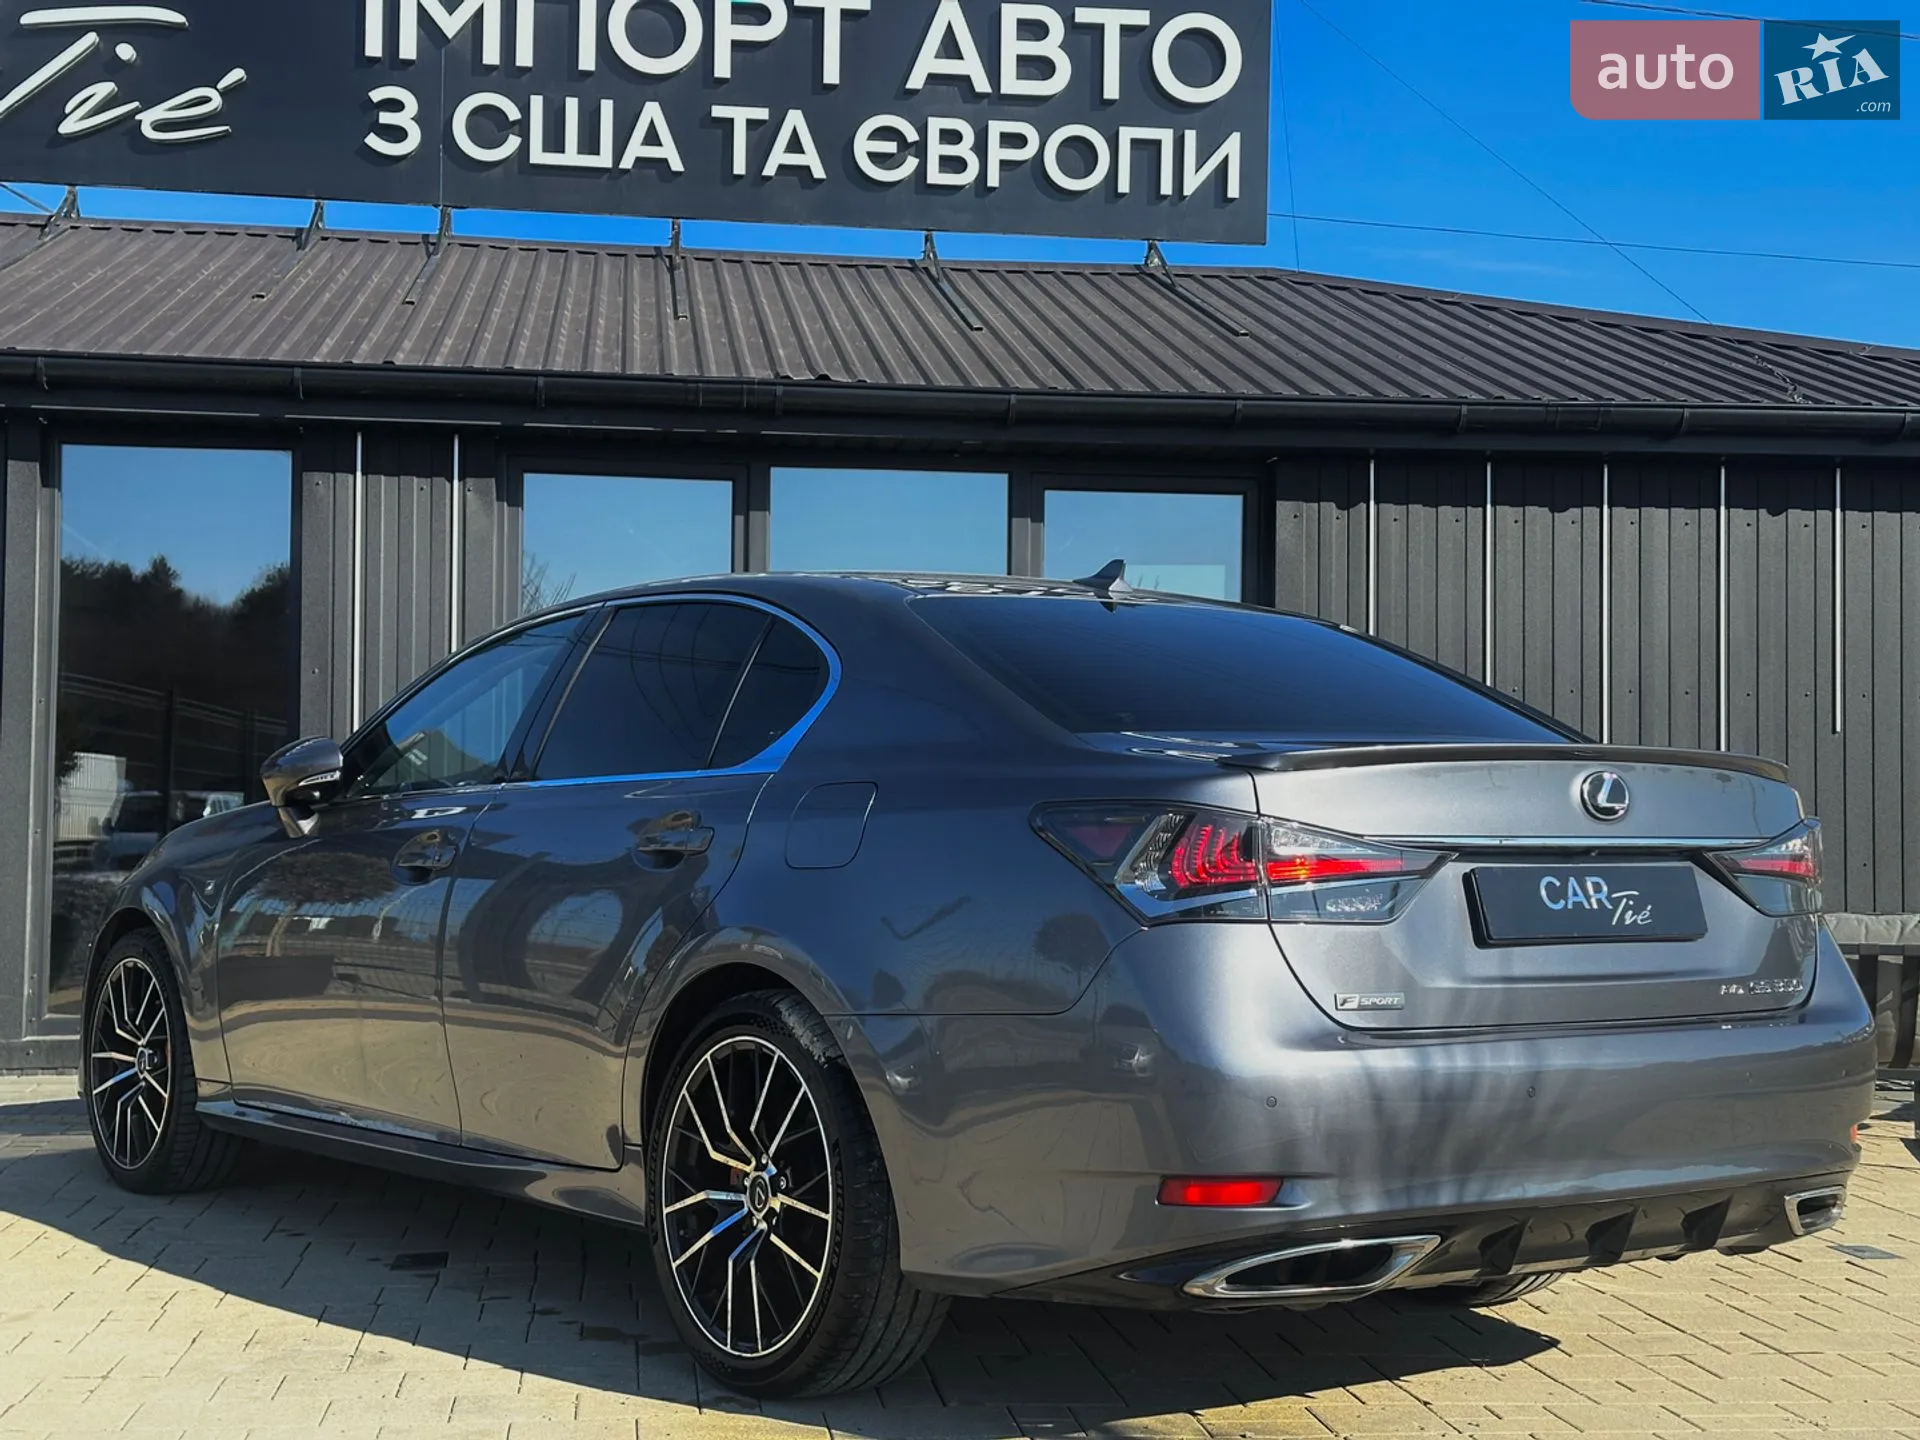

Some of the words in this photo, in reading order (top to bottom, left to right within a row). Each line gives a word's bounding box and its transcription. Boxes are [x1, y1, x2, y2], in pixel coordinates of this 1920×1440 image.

[364, 0, 872, 85] ІМПОРТ
[905, 0, 1243, 103] АВТО
[452, 92, 685, 174] США
[711, 105, 827, 180] ТА
[853, 114, 1242, 200] ЄВРОПИ
[1540, 876, 1613, 910] CAR
[1360, 996, 1401, 1006] SPORT
